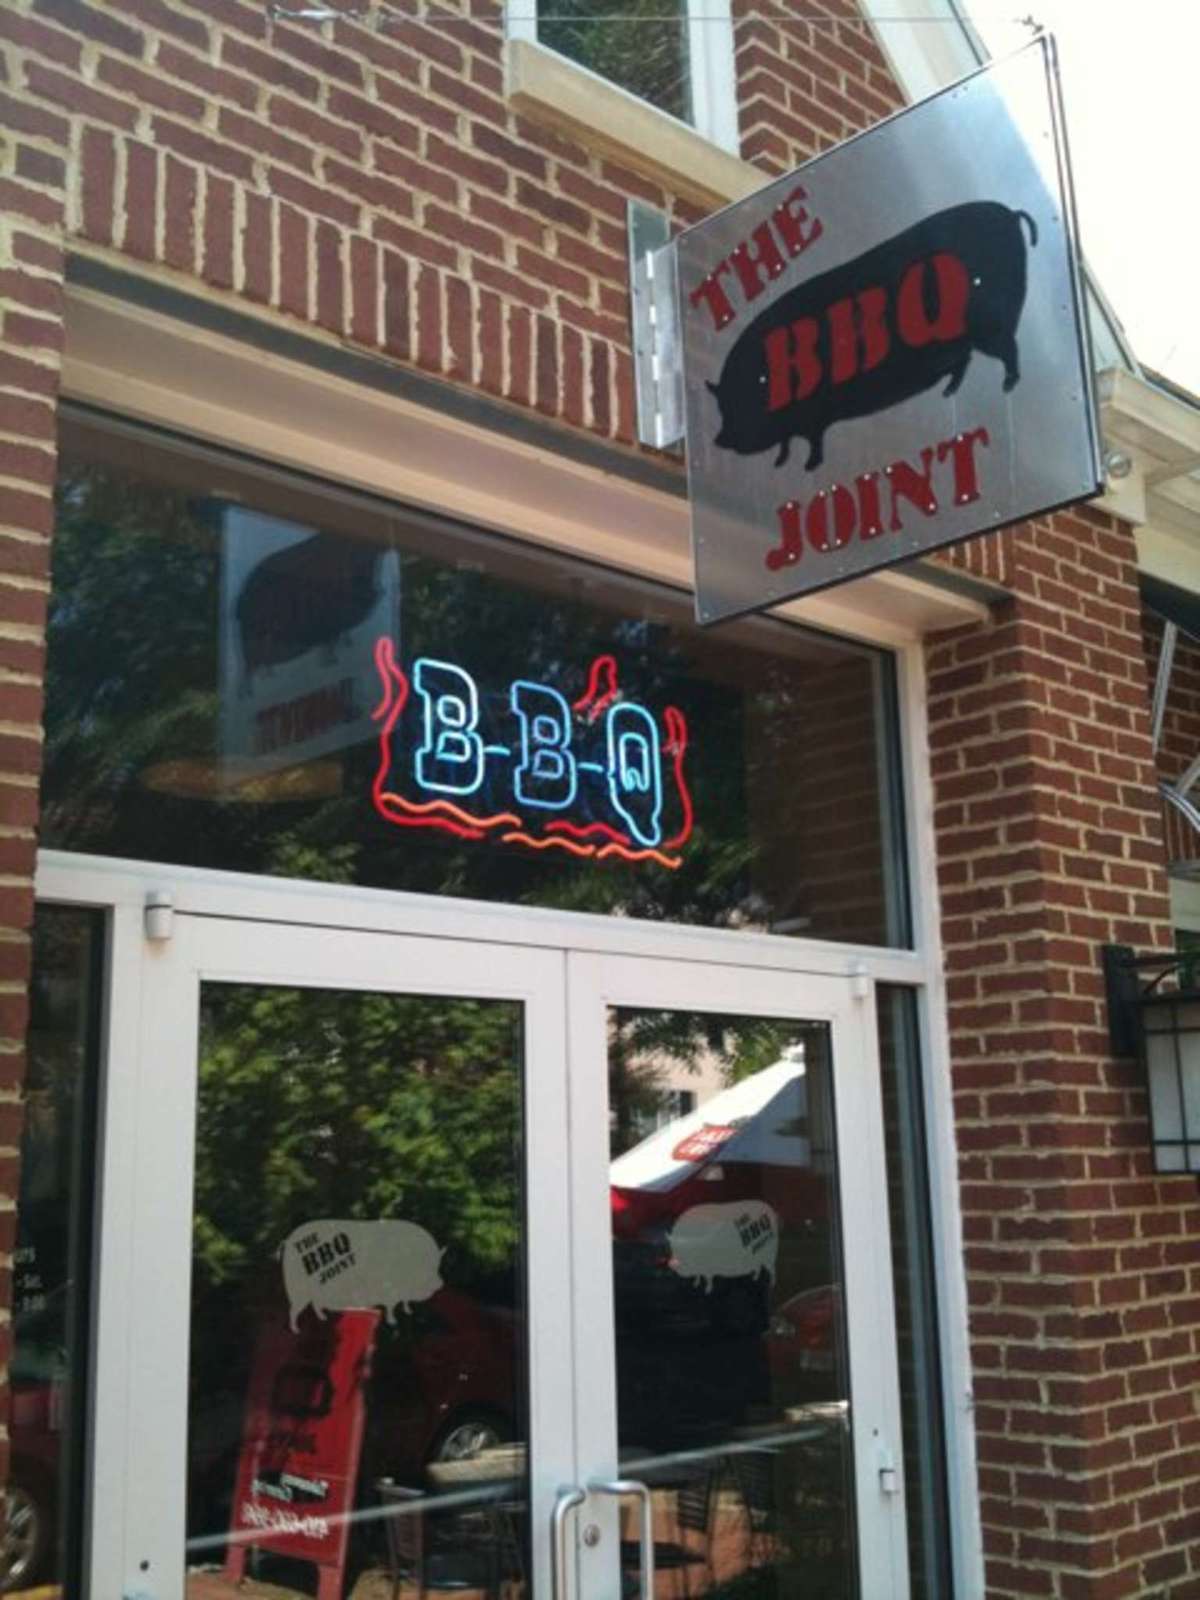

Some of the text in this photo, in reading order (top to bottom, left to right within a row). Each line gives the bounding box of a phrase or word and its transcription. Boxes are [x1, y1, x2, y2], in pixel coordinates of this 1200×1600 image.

[690, 186, 824, 332] THE
[764, 252, 970, 412] BBQ
[765, 427, 989, 570] JOINT
[302, 1232, 351, 1276] BBQ
